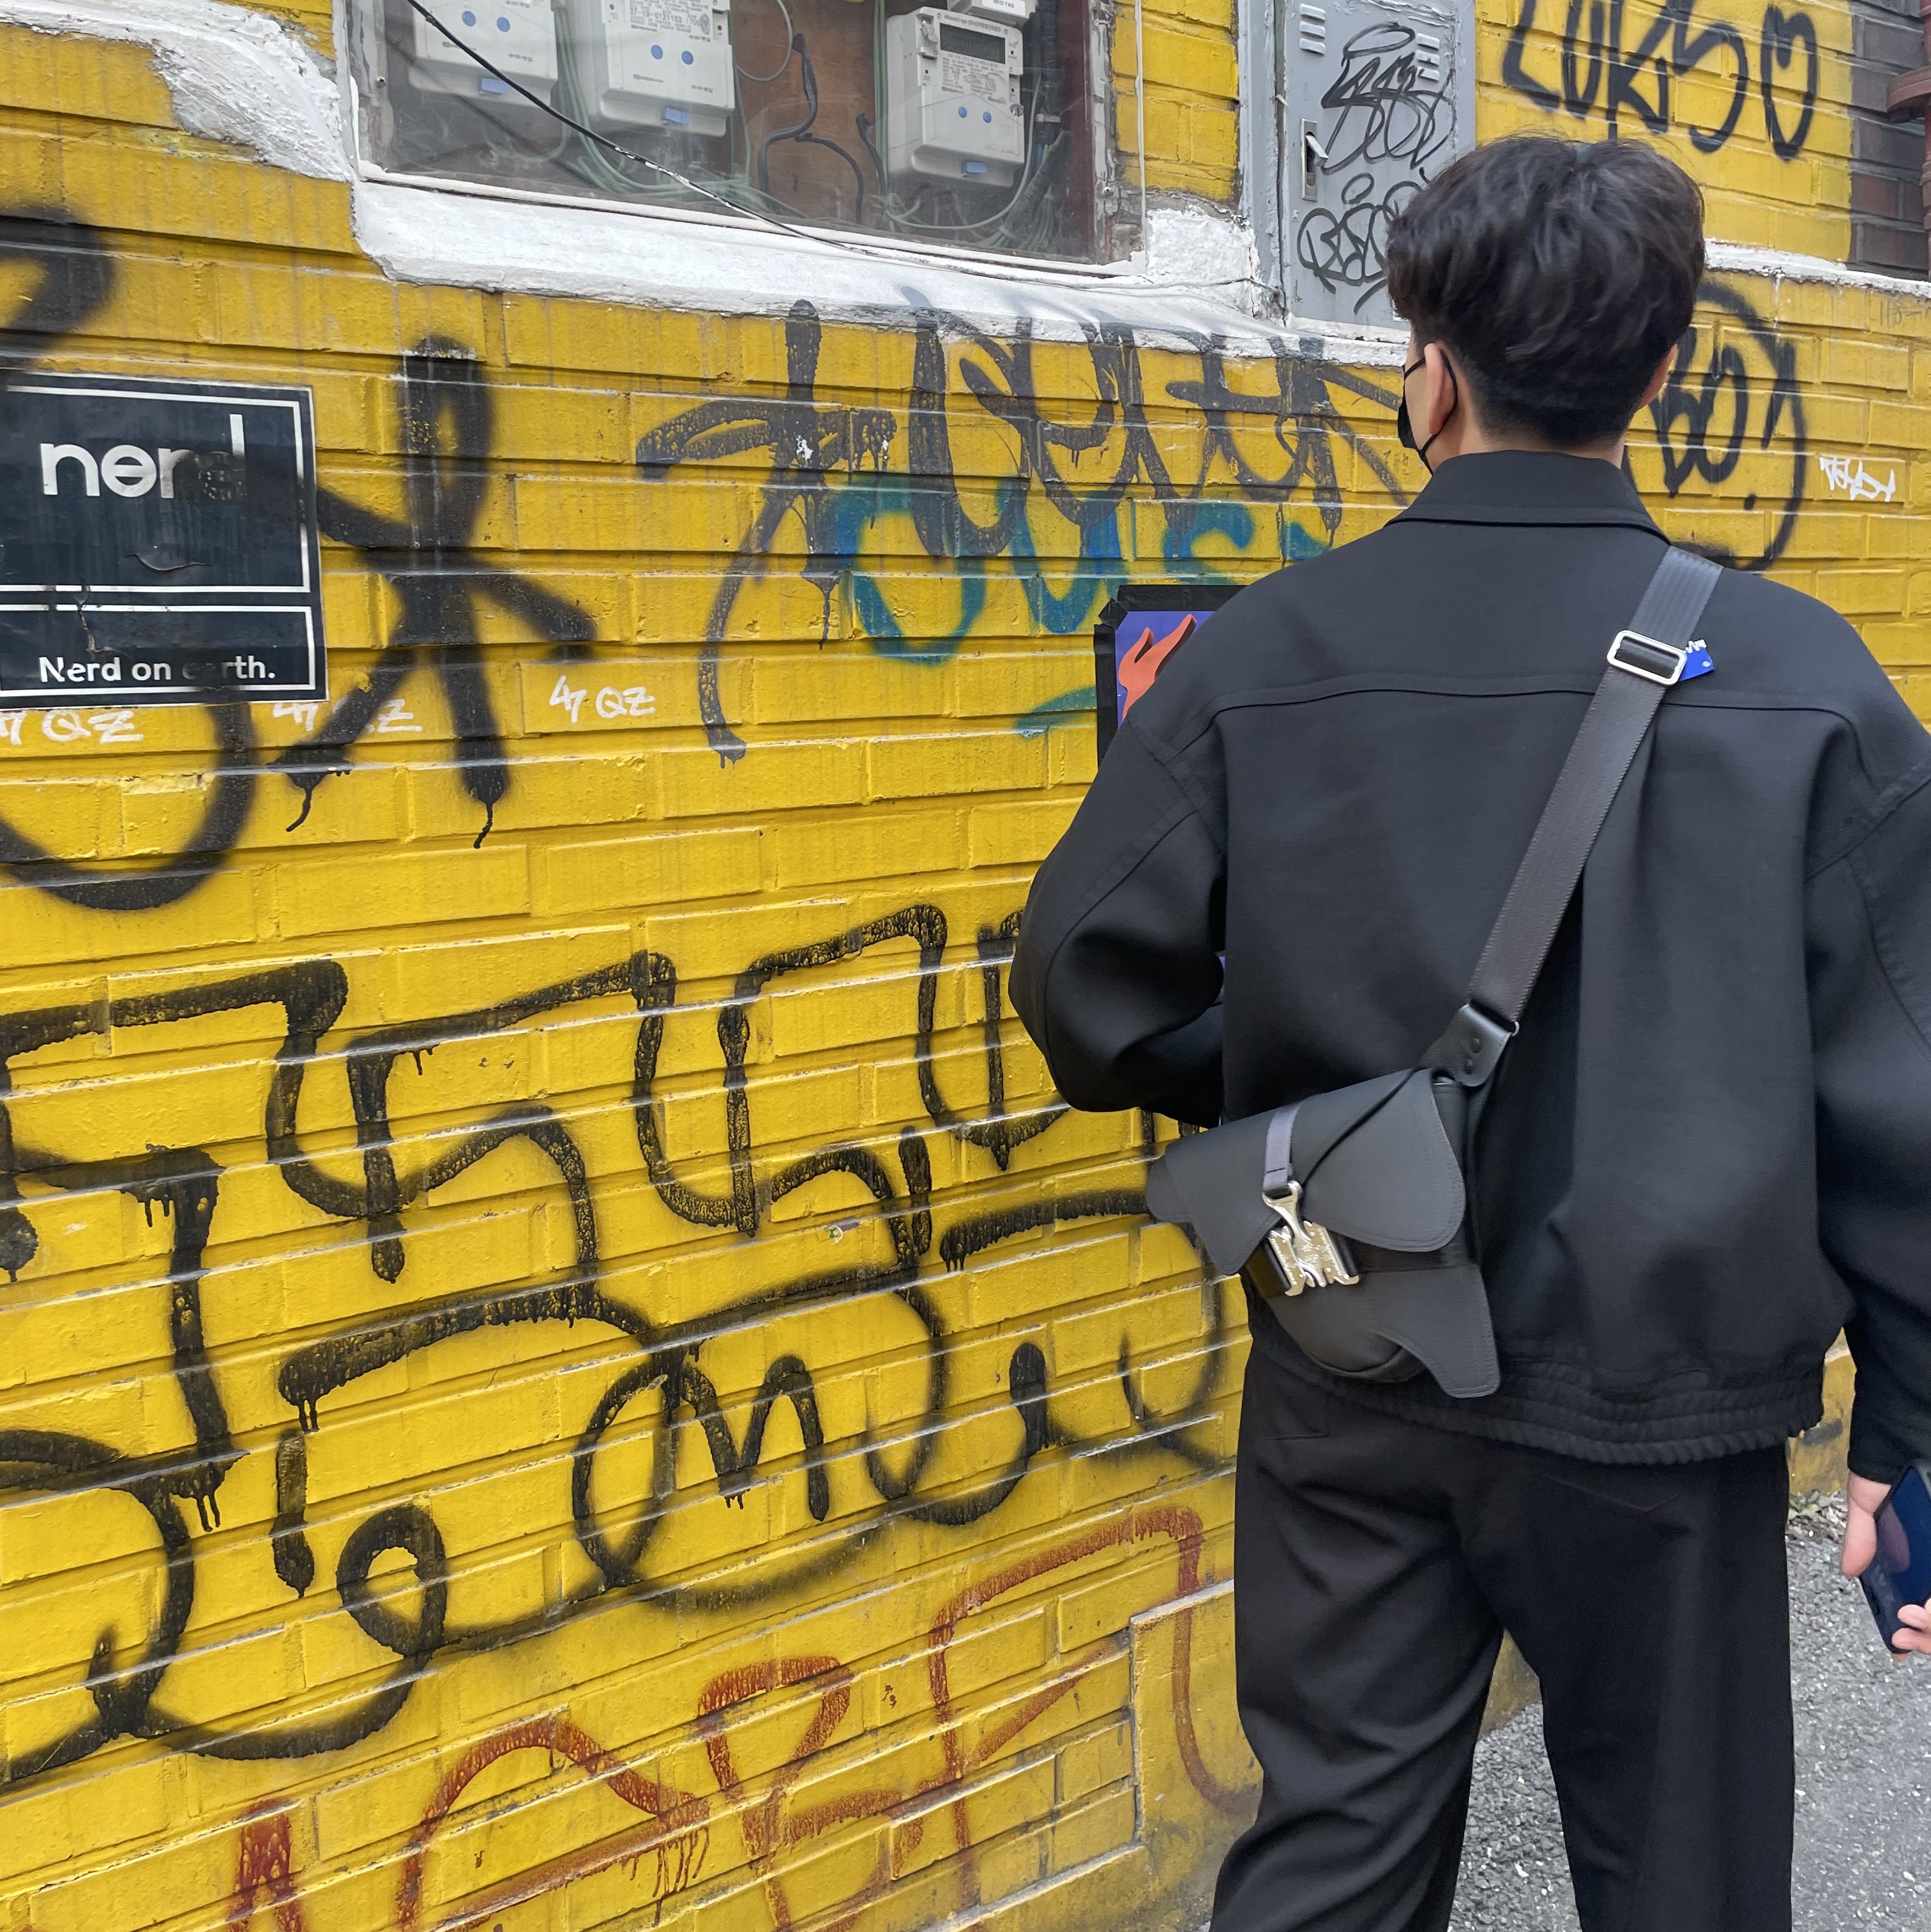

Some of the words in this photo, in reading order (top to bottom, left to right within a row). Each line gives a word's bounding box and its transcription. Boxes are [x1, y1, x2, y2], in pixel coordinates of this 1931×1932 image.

[39, 656, 121, 683] Nerd
[132, 662, 172, 681] on
[183, 655, 276, 681] erth.
